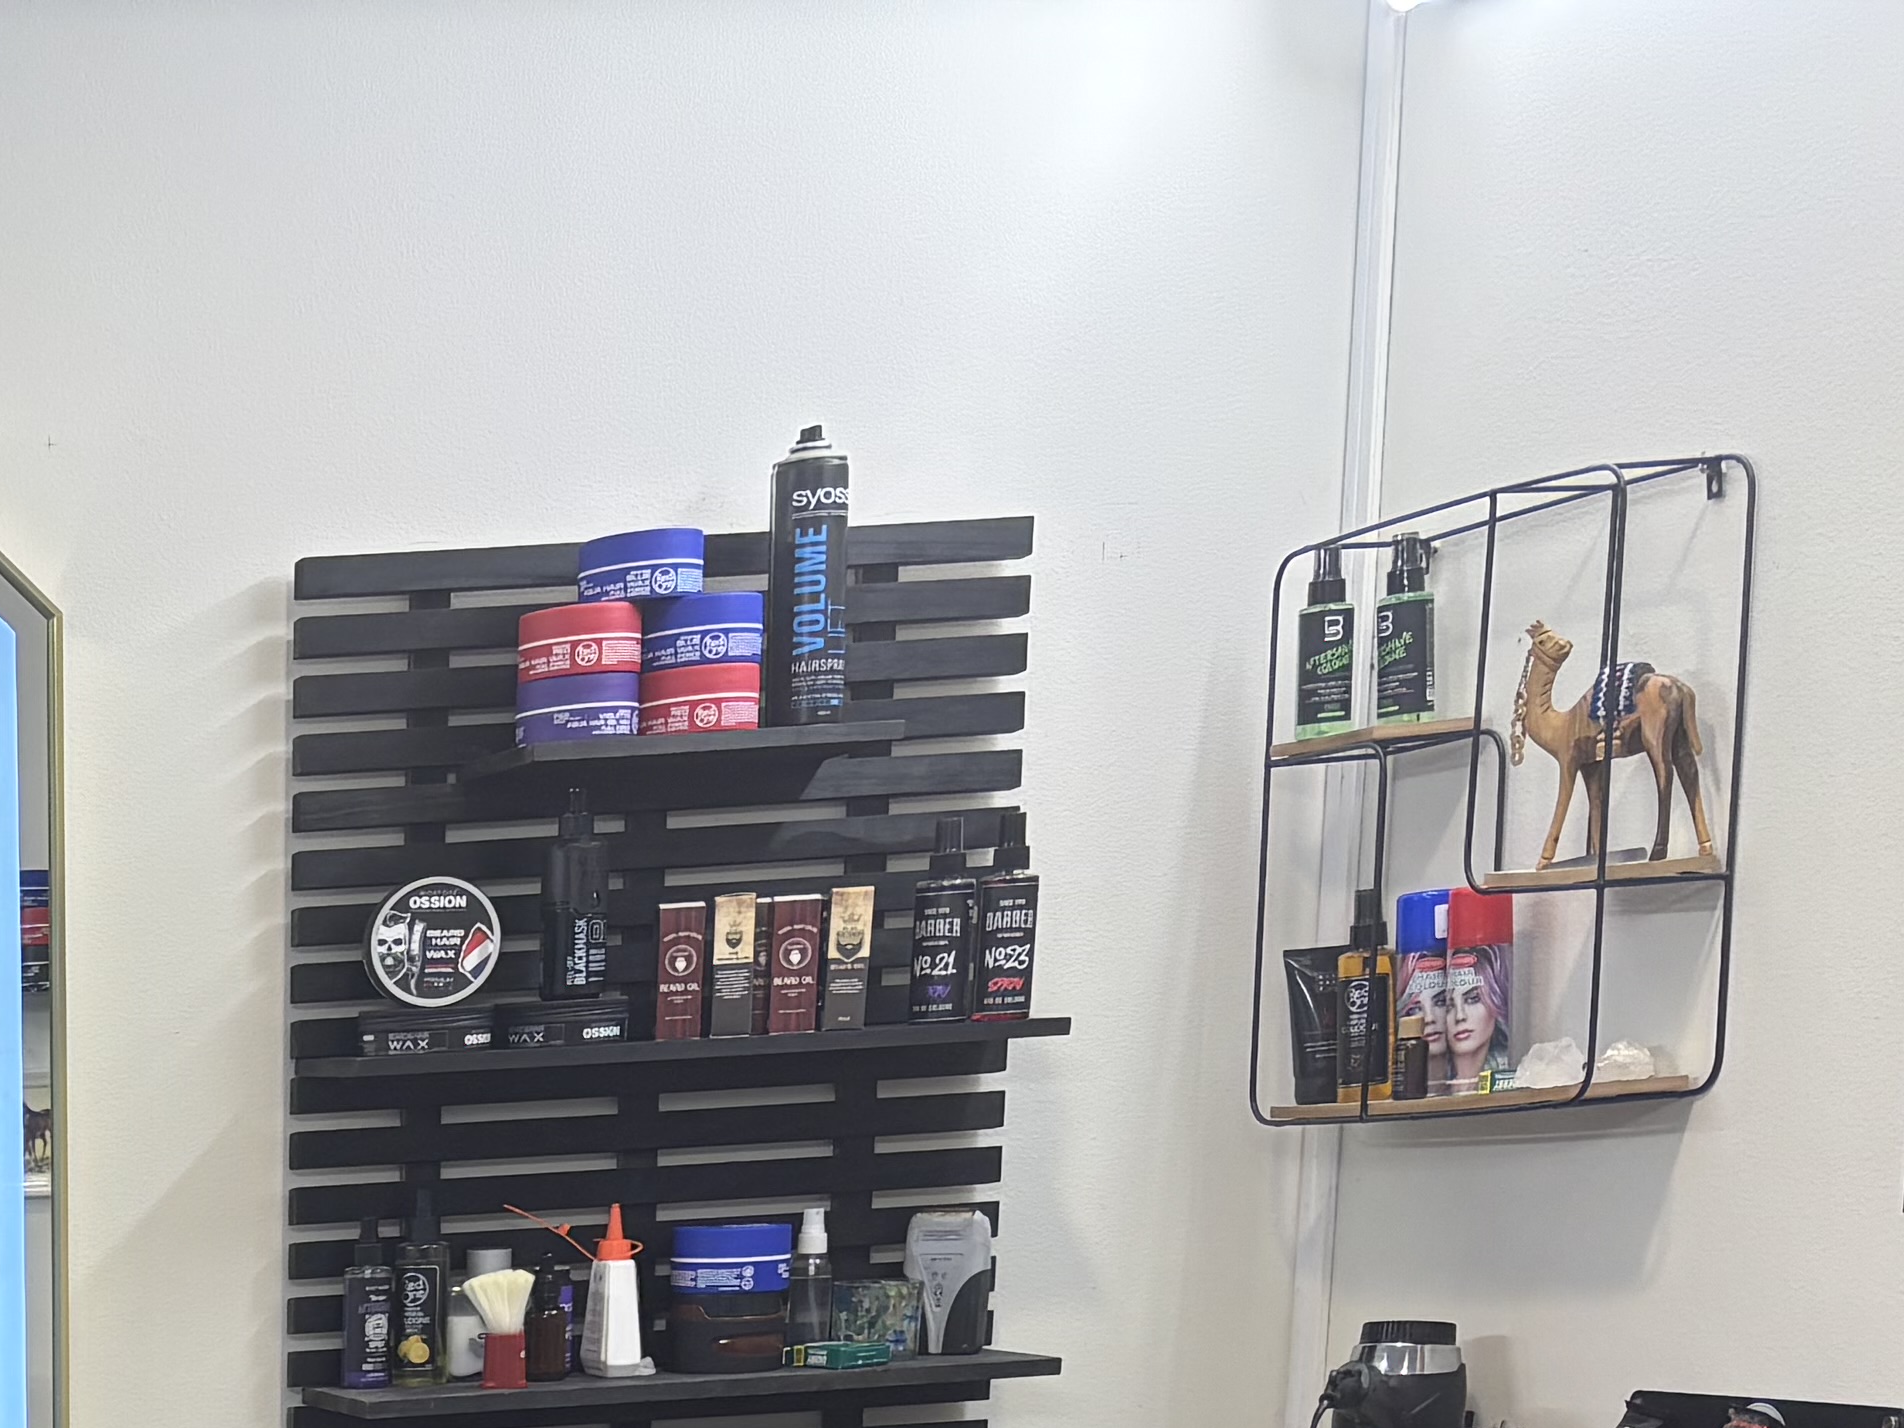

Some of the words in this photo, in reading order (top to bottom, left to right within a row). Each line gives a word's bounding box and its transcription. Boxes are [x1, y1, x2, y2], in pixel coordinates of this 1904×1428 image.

[792, 524, 828, 656] VOLUME
[409, 895, 467, 909] OSSION
[915, 918, 961, 940] BARBER
[425, 949, 455, 959] WAX
[573, 918, 588, 985] BLACKMASK
[508, 1032, 544, 1044] WAX
[582, 1026, 621, 1039] OSSION
[388, 1039, 429, 1050] WAX
